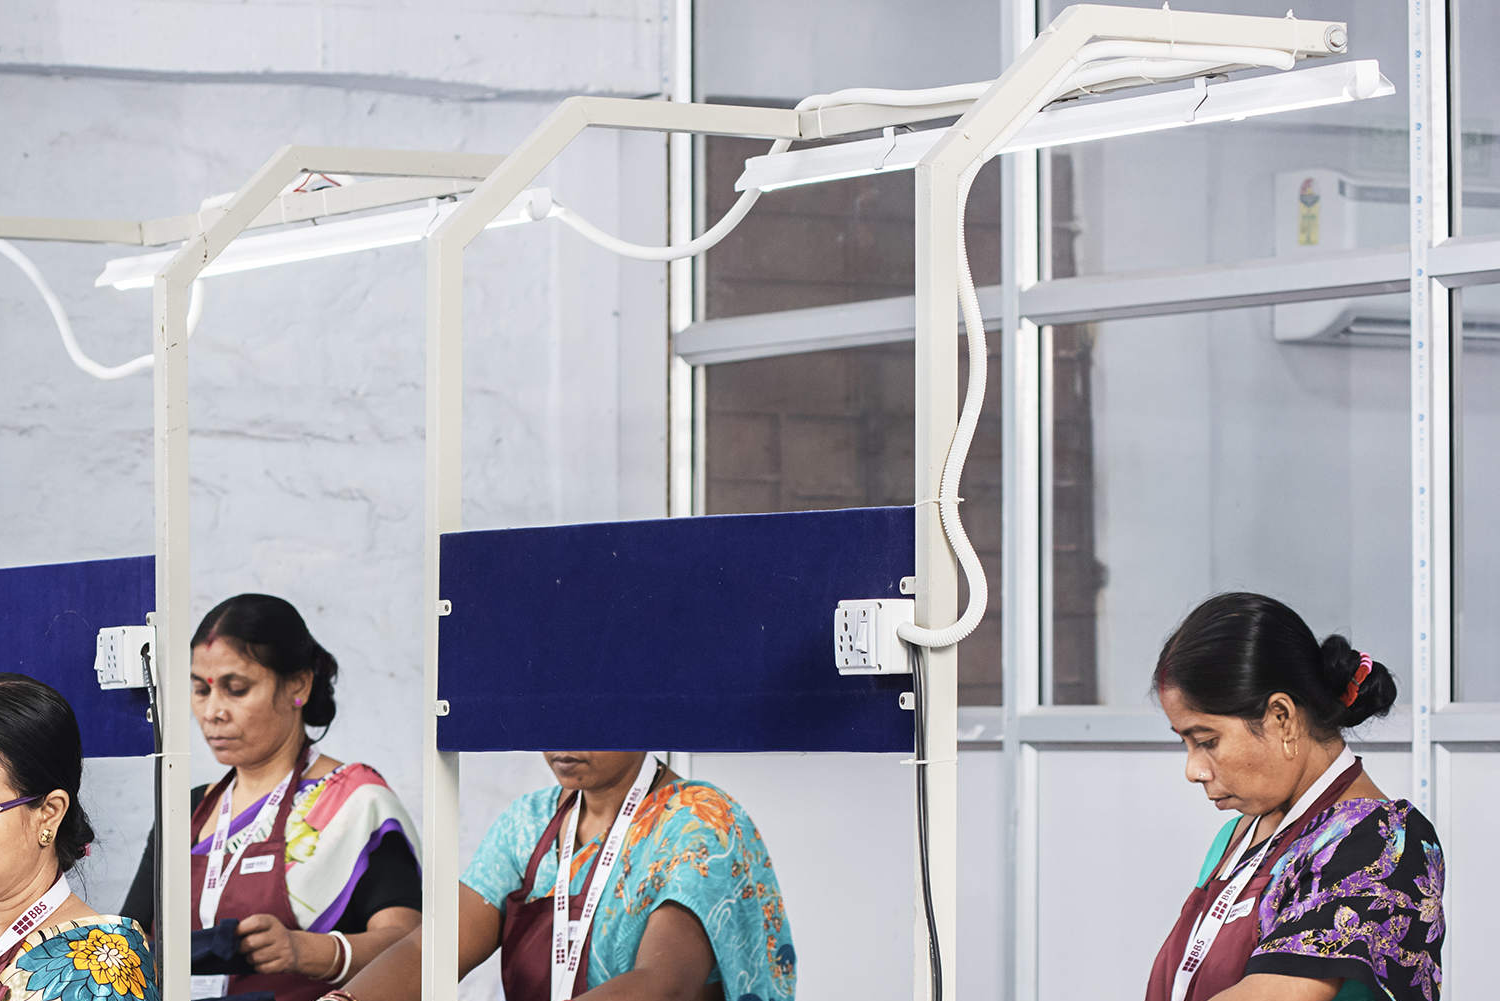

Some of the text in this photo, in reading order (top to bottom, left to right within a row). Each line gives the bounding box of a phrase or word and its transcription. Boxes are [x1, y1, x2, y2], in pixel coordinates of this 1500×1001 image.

[1221, 885, 1237, 900] BBS
[28, 901, 47, 919] BBS
[1191, 939, 1205, 957] BBS
